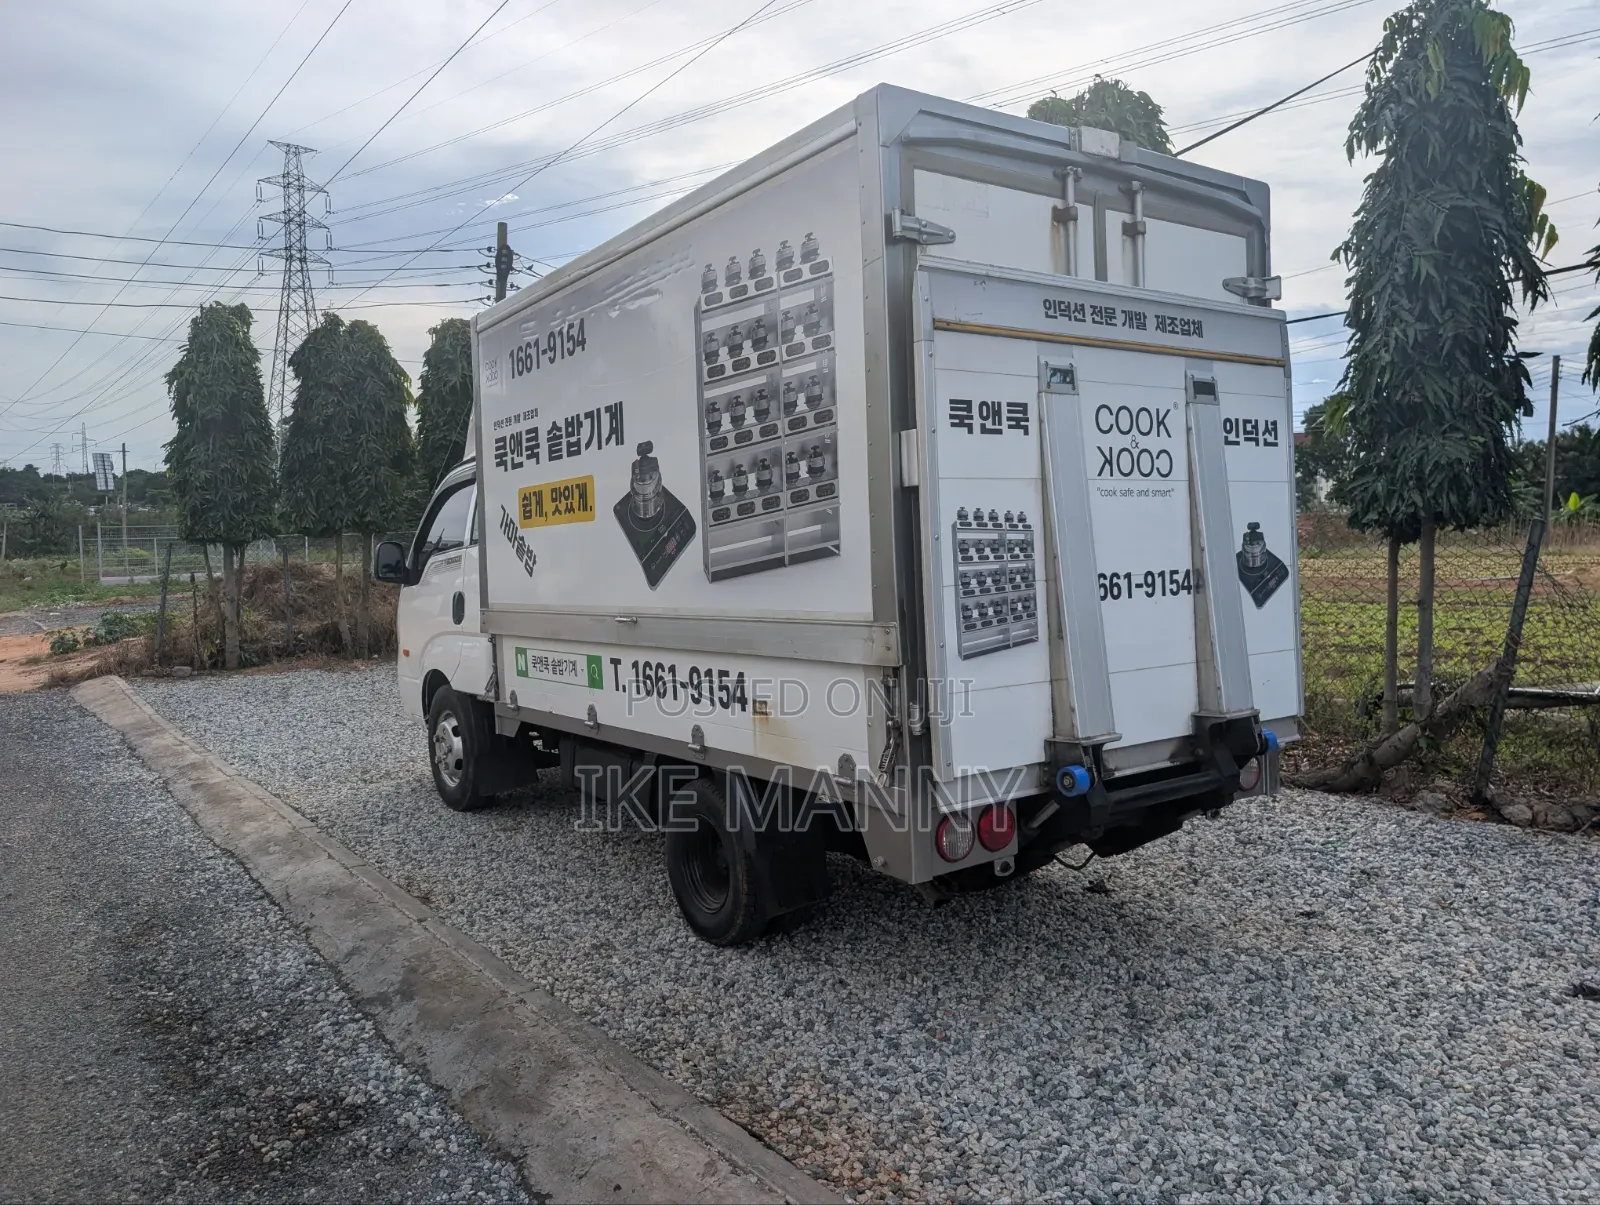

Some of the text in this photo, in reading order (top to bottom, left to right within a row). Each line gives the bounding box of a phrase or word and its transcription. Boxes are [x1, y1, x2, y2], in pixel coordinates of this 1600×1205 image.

[1042, 299, 1204, 338] 인덕션 전문 개발 제조업체
[508, 317, 587, 379] 1661-9154
[949, 398, 1029, 436] 쿡앤쿡
[1095, 404, 1172, 438] COOK
[1222, 417, 1279, 447] 인덕션
[494, 401, 625, 472] 쿡앤쿡 솥밥기계
[1130, 434, 1139, 449] &
[521, 481, 593, 521] 쉽게, 맛있게.
[1119, 488, 1134, 497] safe
[1136, 488, 1149, 497] and
[517, 653, 526, 671] N
[531, 655, 578, 677] 쿡앤쿡 솥밥기계
